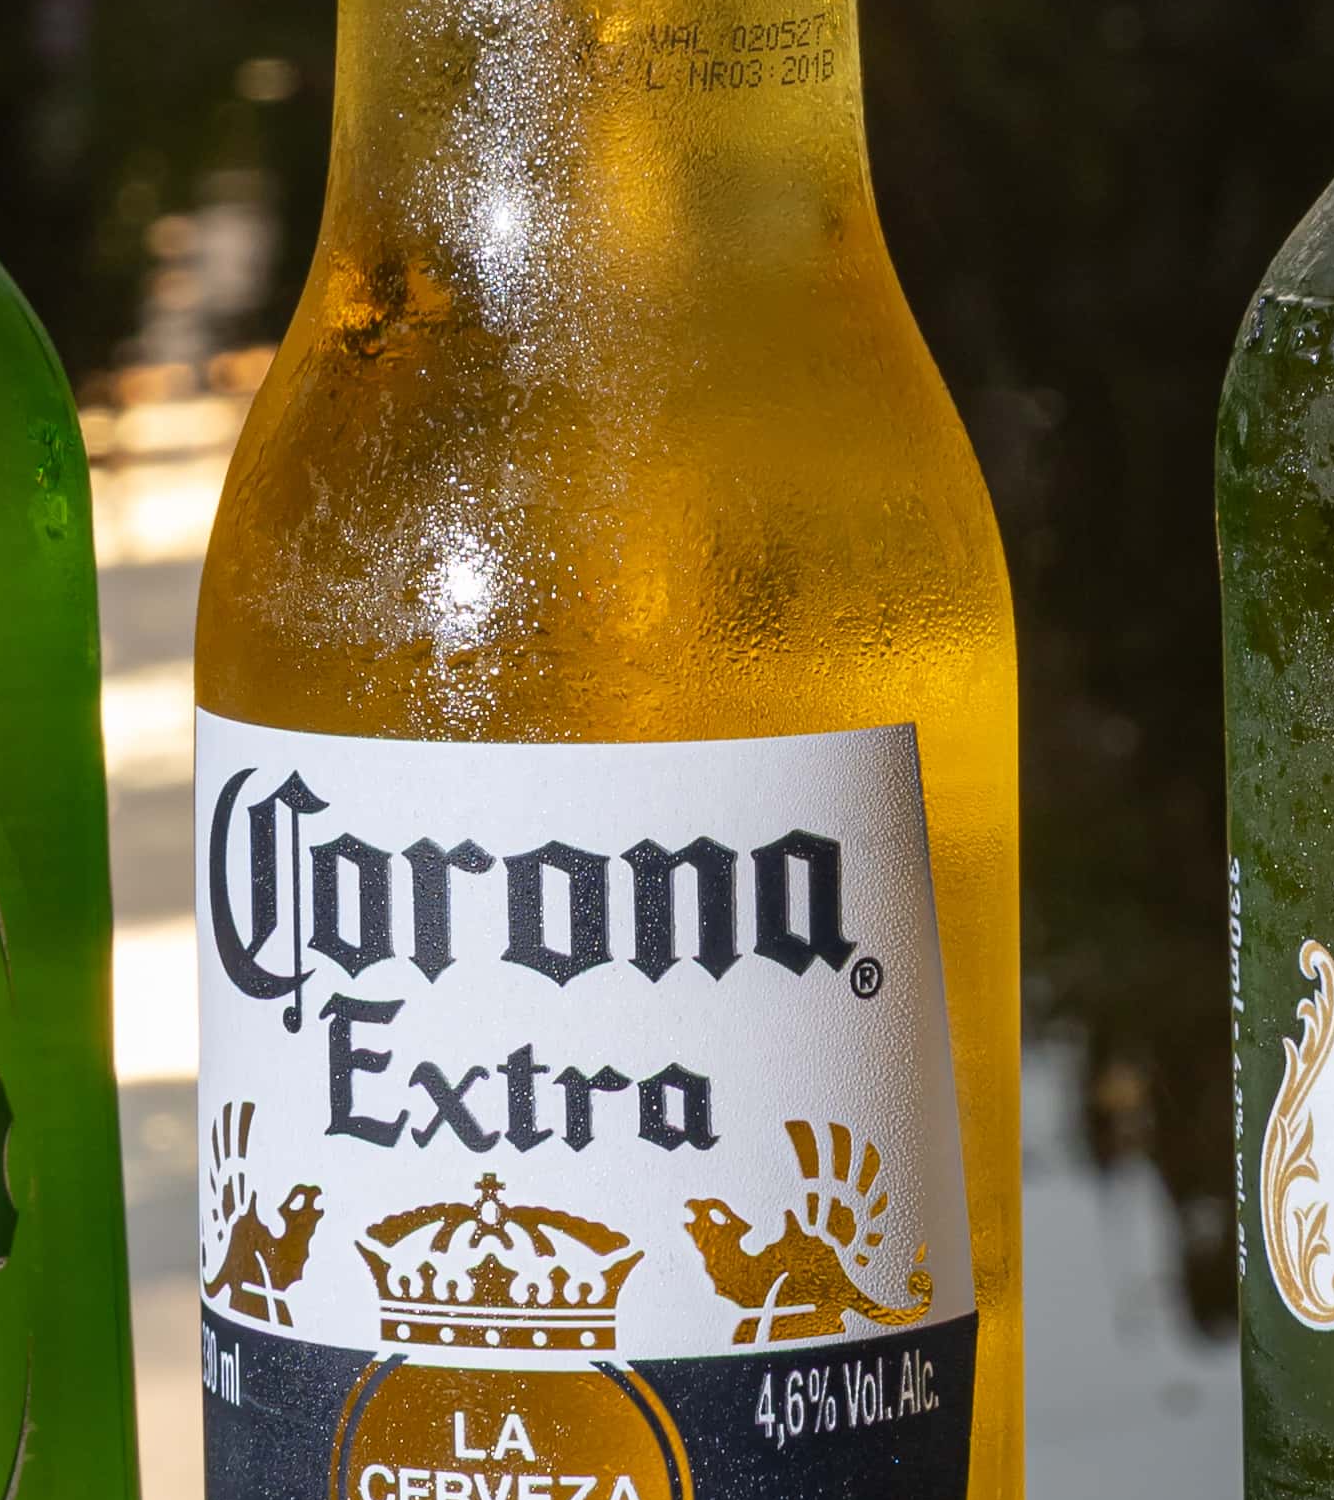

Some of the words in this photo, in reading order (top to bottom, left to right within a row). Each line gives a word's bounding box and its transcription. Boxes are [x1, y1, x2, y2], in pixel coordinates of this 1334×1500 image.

[319, 992, 721, 1153] Extra
[219, 1342, 241, 1406] ml
[753, 1365, 837, 1450] 4,6%
[842, 1355, 894, 1429] Vol.
[896, 1348, 941, 1418] Alc.
[453, 1411, 536, 1462] LA
